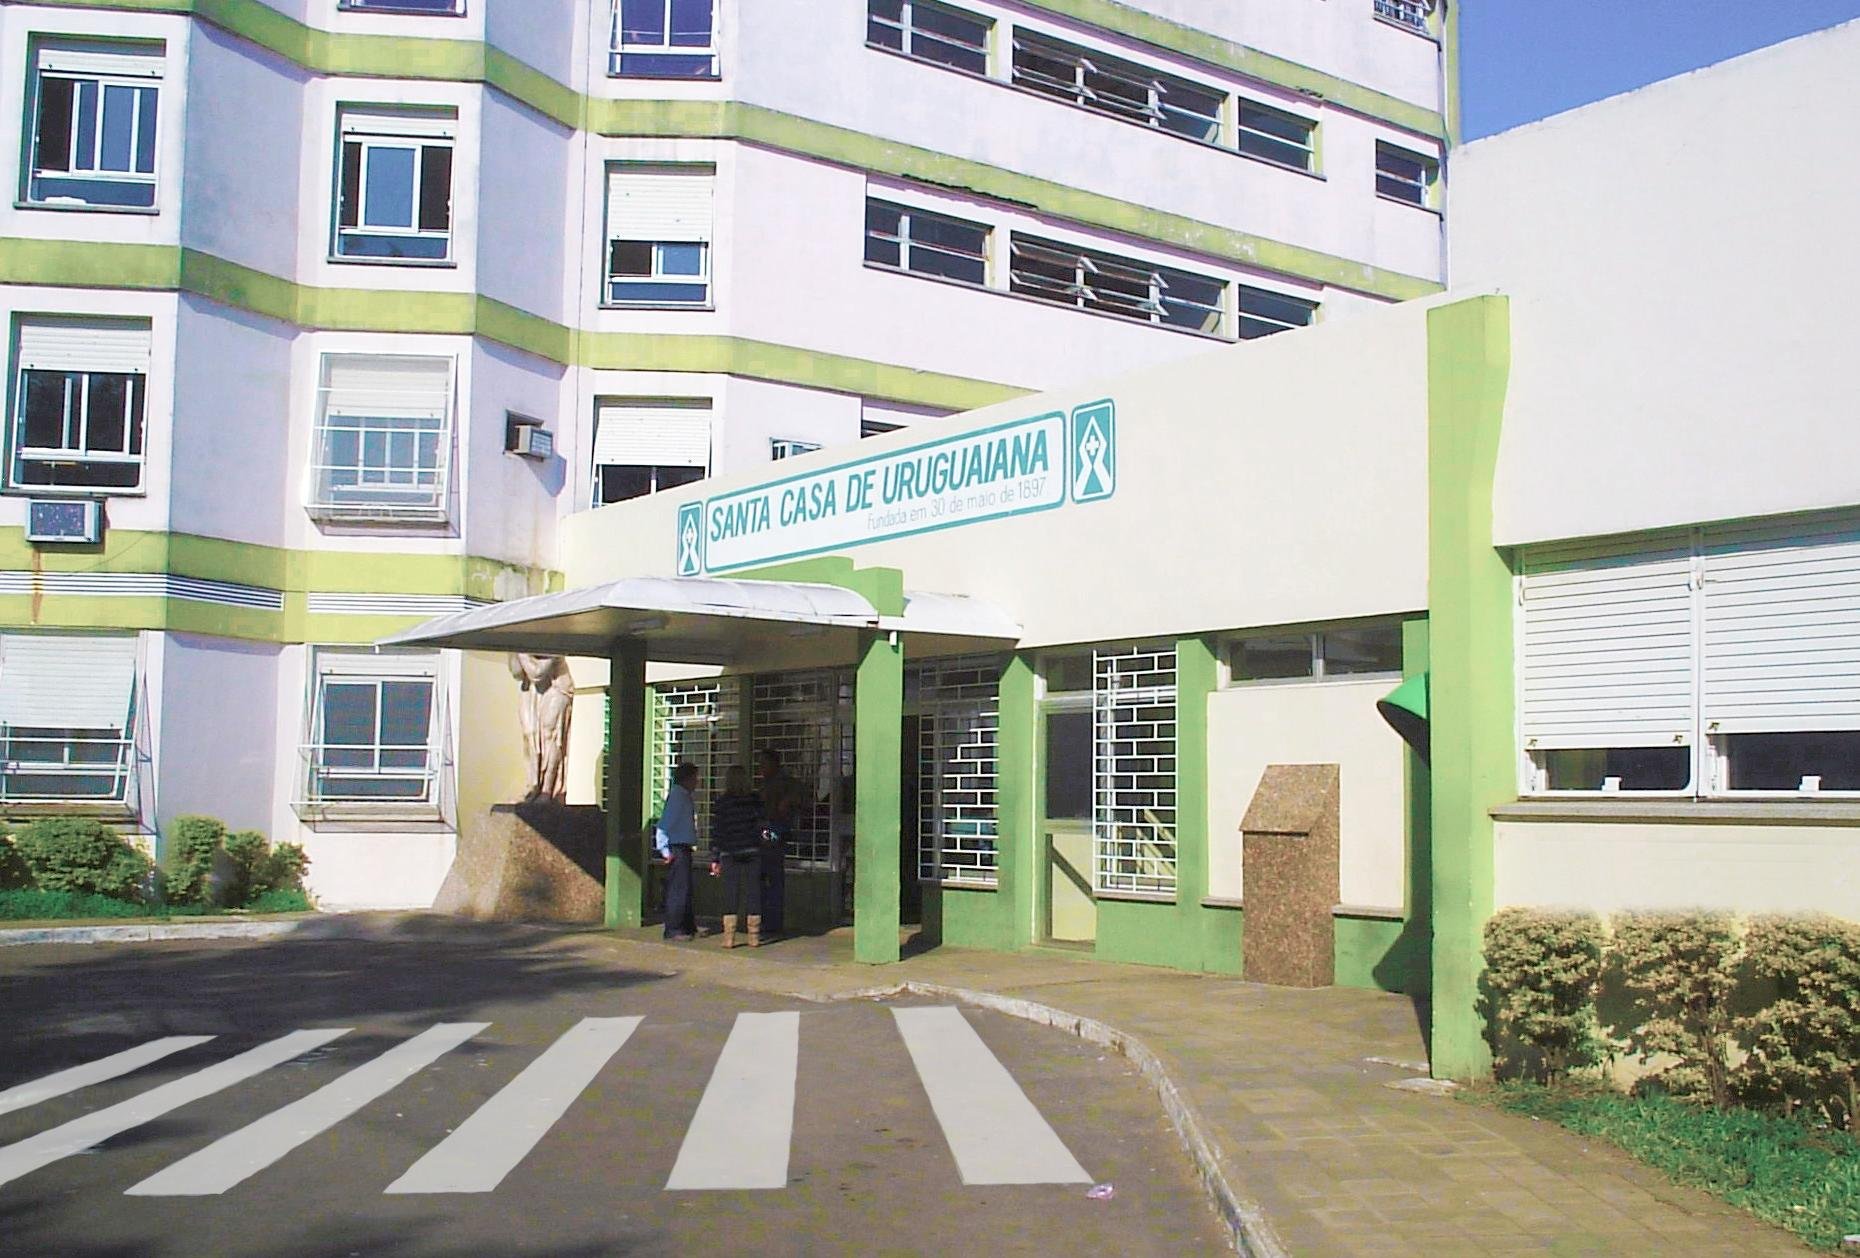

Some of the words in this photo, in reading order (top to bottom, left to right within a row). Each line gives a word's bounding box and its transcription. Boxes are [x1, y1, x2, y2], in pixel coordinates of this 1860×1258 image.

[711, 496, 770, 541] SANTA
[780, 479, 836, 526] CASA
[846, 470, 876, 512] DE
[882, 429, 1048, 504] URUGUAIANA
[867, 508, 907, 530] Fundada
[910, 506, 927, 521] em
[931, 497, 945, 517] 30
[949, 496, 963, 513] de
[967, 491, 996, 510] maio
[1000, 484, 1014, 503] de
[1019, 477, 1047, 499] 1897
